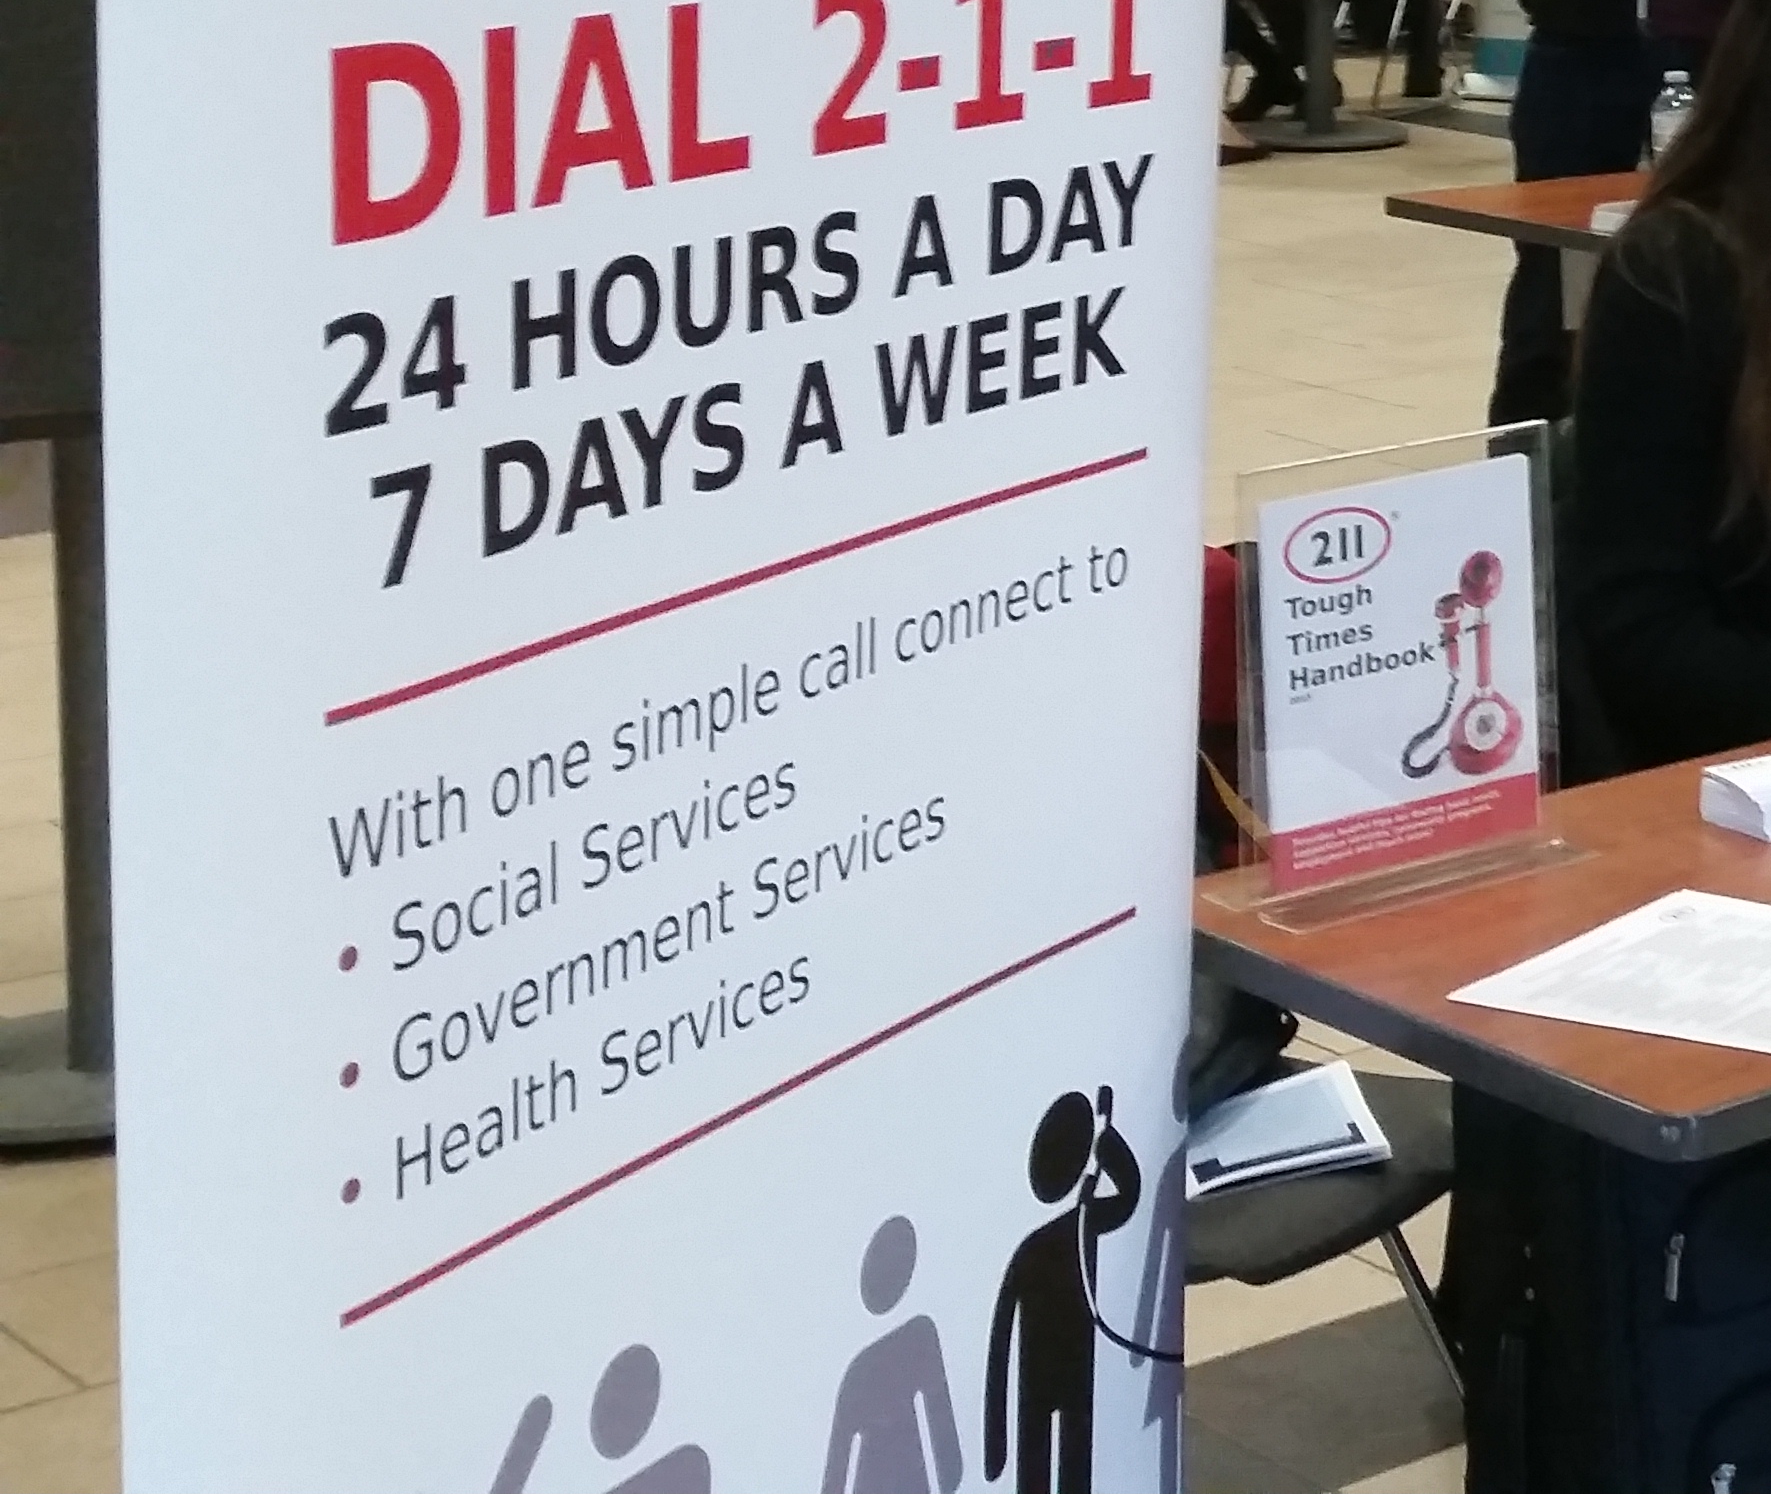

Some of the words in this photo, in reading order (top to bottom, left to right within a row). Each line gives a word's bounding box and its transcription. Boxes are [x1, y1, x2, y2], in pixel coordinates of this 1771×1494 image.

[329, 2, 750, 245] DIAL
[323, 294, 466, 437] 24
[511, 210, 862, 392] HOURS
[893, 195, 953, 298] A
[988, 153, 1156, 276] DAY
[370, 465, 433, 589] 7
[481, 382, 745, 557] DAYS
[781, 360, 843, 469] A
[875, 287, 1127, 437] WEEK
[1311, 524, 1364, 568] 211
[329, 776, 468, 878] With
[491, 739, 591, 819] one
[612, 664, 780, 773] simple
[798, 618, 877, 701] call
[895, 558, 1074, 664] connect
[1089, 543, 1129, 597] to
[1284, 584, 1374, 621] Tough
[1286, 620, 1374, 657] Times
[1289, 642, 1435, 692] Handbook
[393, 841, 558, 972] Social
[582, 759, 797, 890] Services
[393, 880, 736, 1083] Government
[753, 793, 946, 918] Services
[396, 1061, 577, 1201] Health
[600, 952, 813, 1094] Services
